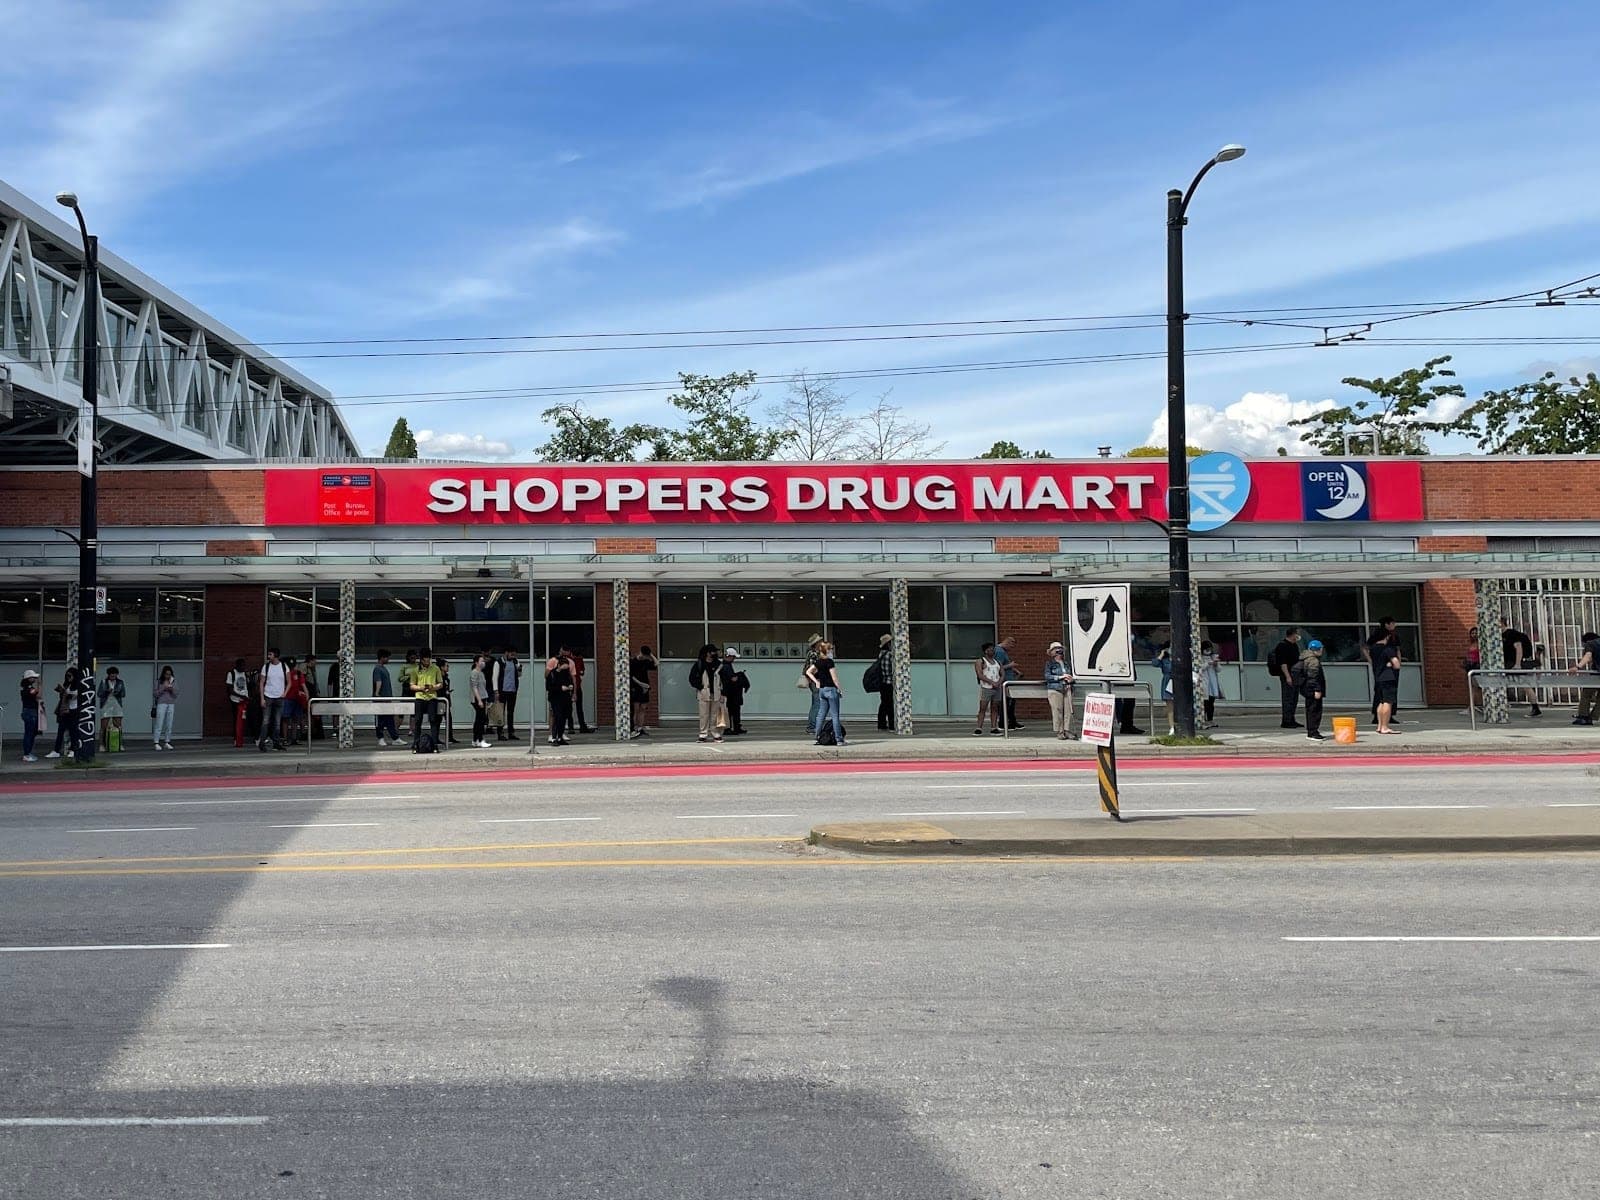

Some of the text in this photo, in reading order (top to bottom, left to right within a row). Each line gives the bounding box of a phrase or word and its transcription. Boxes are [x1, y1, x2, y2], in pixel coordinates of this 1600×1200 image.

[1308, 471, 1345, 482] OPEN
[426, 475, 1155, 513] SHOPPERS DRUG MART
[1327, 486, 1360, 500] 12 AM
